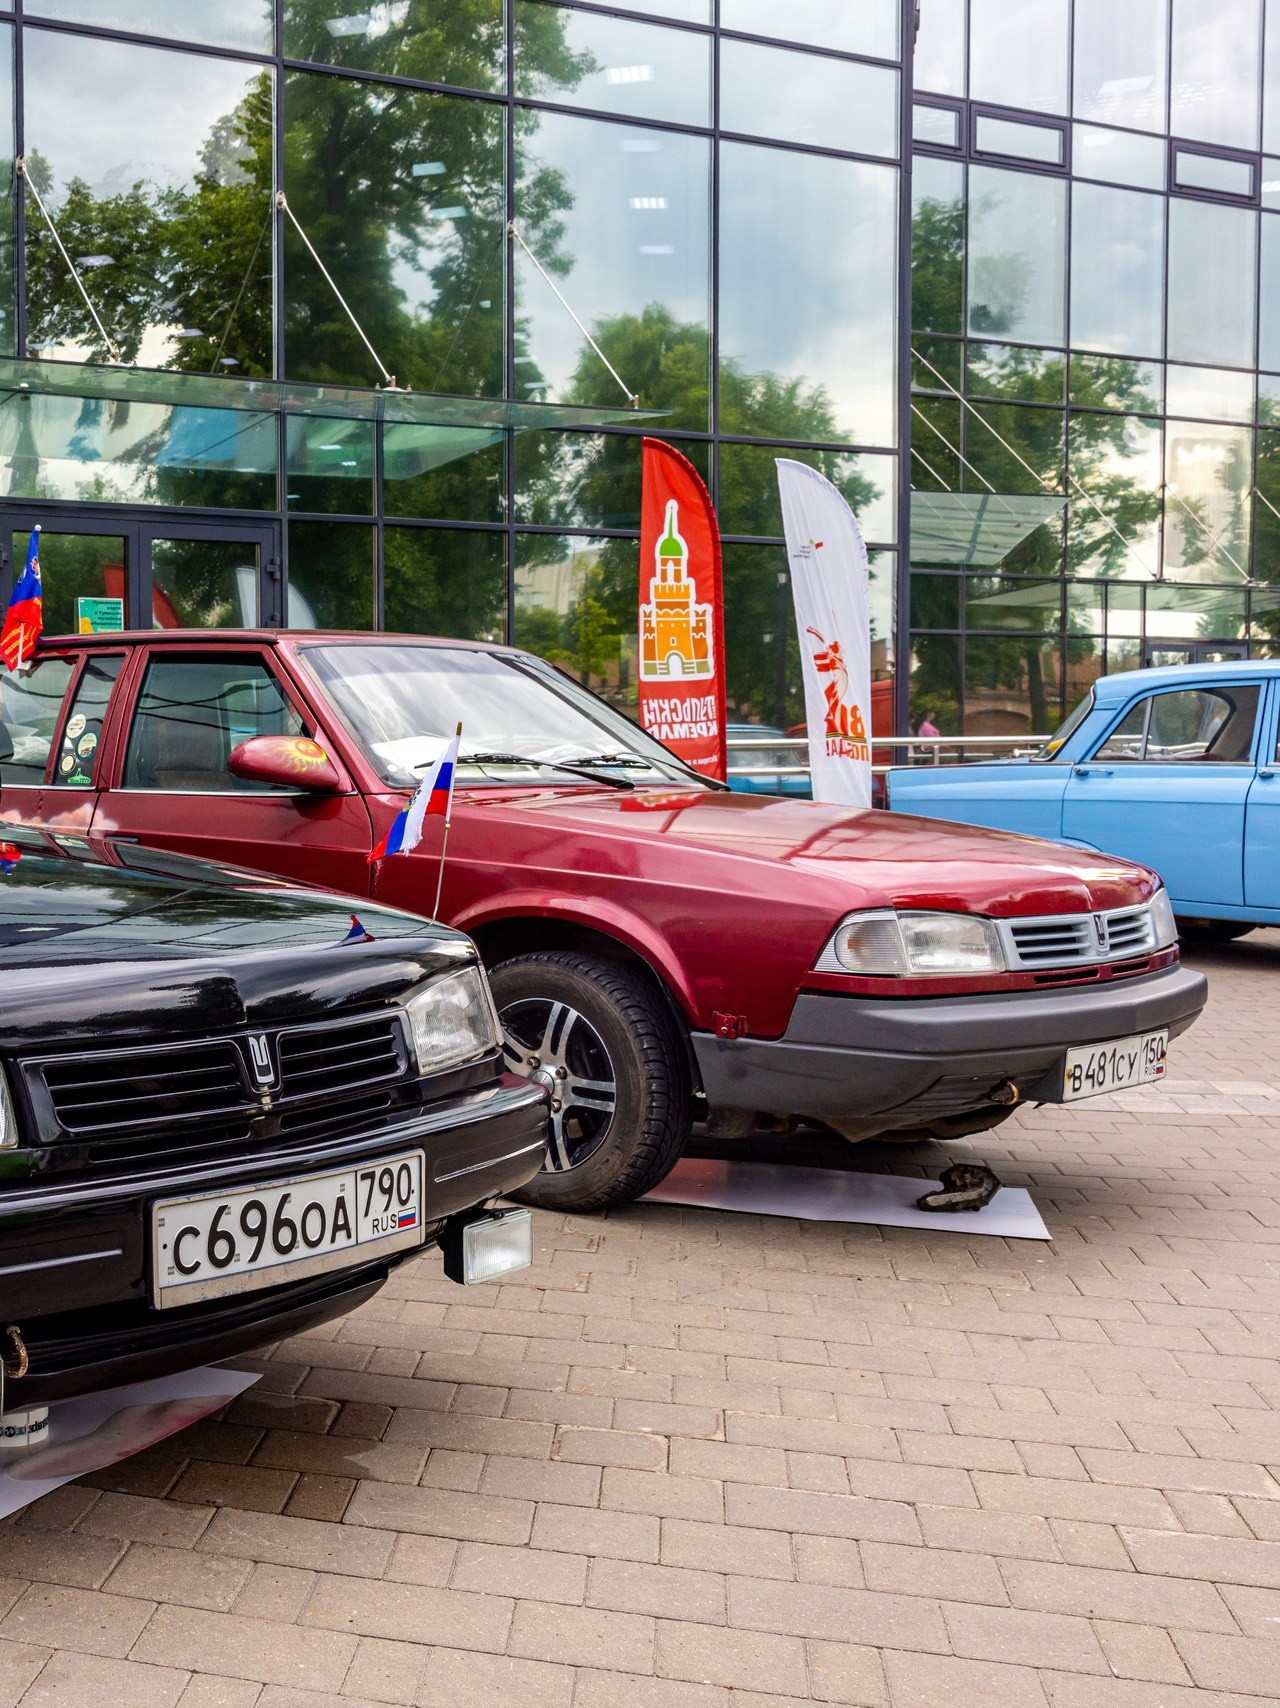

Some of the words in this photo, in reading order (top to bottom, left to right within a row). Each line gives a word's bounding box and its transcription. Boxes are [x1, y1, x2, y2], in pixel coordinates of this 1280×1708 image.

[1072, 1047, 1138, 1093] В481СУ
[1142, 1036, 1164, 1067] 150
[1144, 1065, 1156, 1076] RUS
[173, 1193, 352, 1275] С696ОА
[360, 1162, 412, 1219] 790
[372, 1214, 397, 1236] RUS
